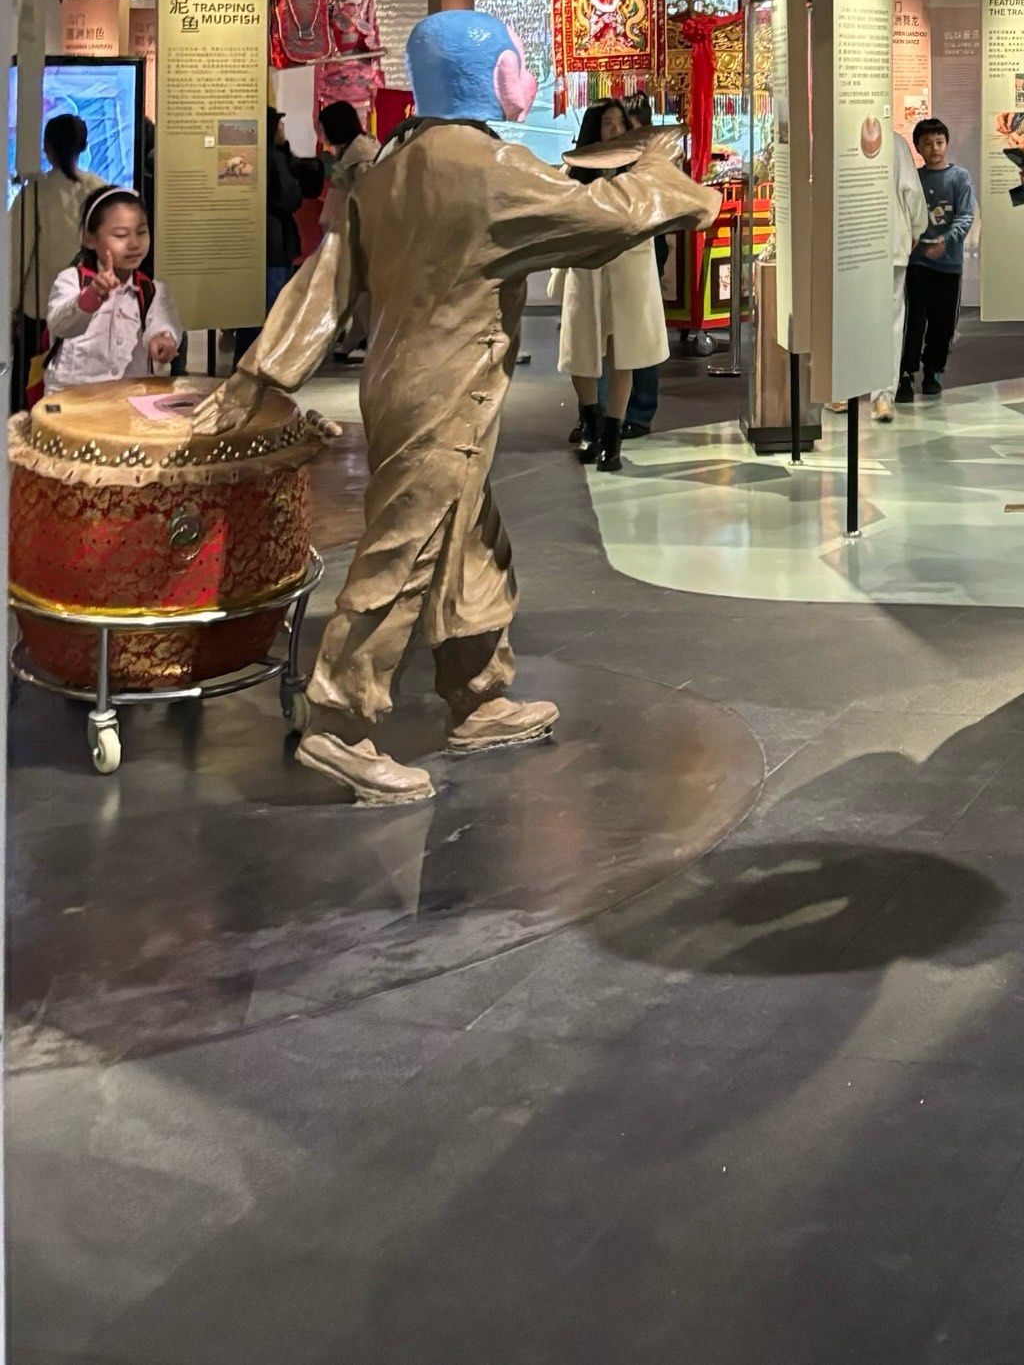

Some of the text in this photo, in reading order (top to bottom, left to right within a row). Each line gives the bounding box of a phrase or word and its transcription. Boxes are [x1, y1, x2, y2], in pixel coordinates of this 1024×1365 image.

[192, 3, 255, 13] TRAPPING
[989, 8, 1006, 16] THE
[201, 15, 260, 25] MUDFISH
